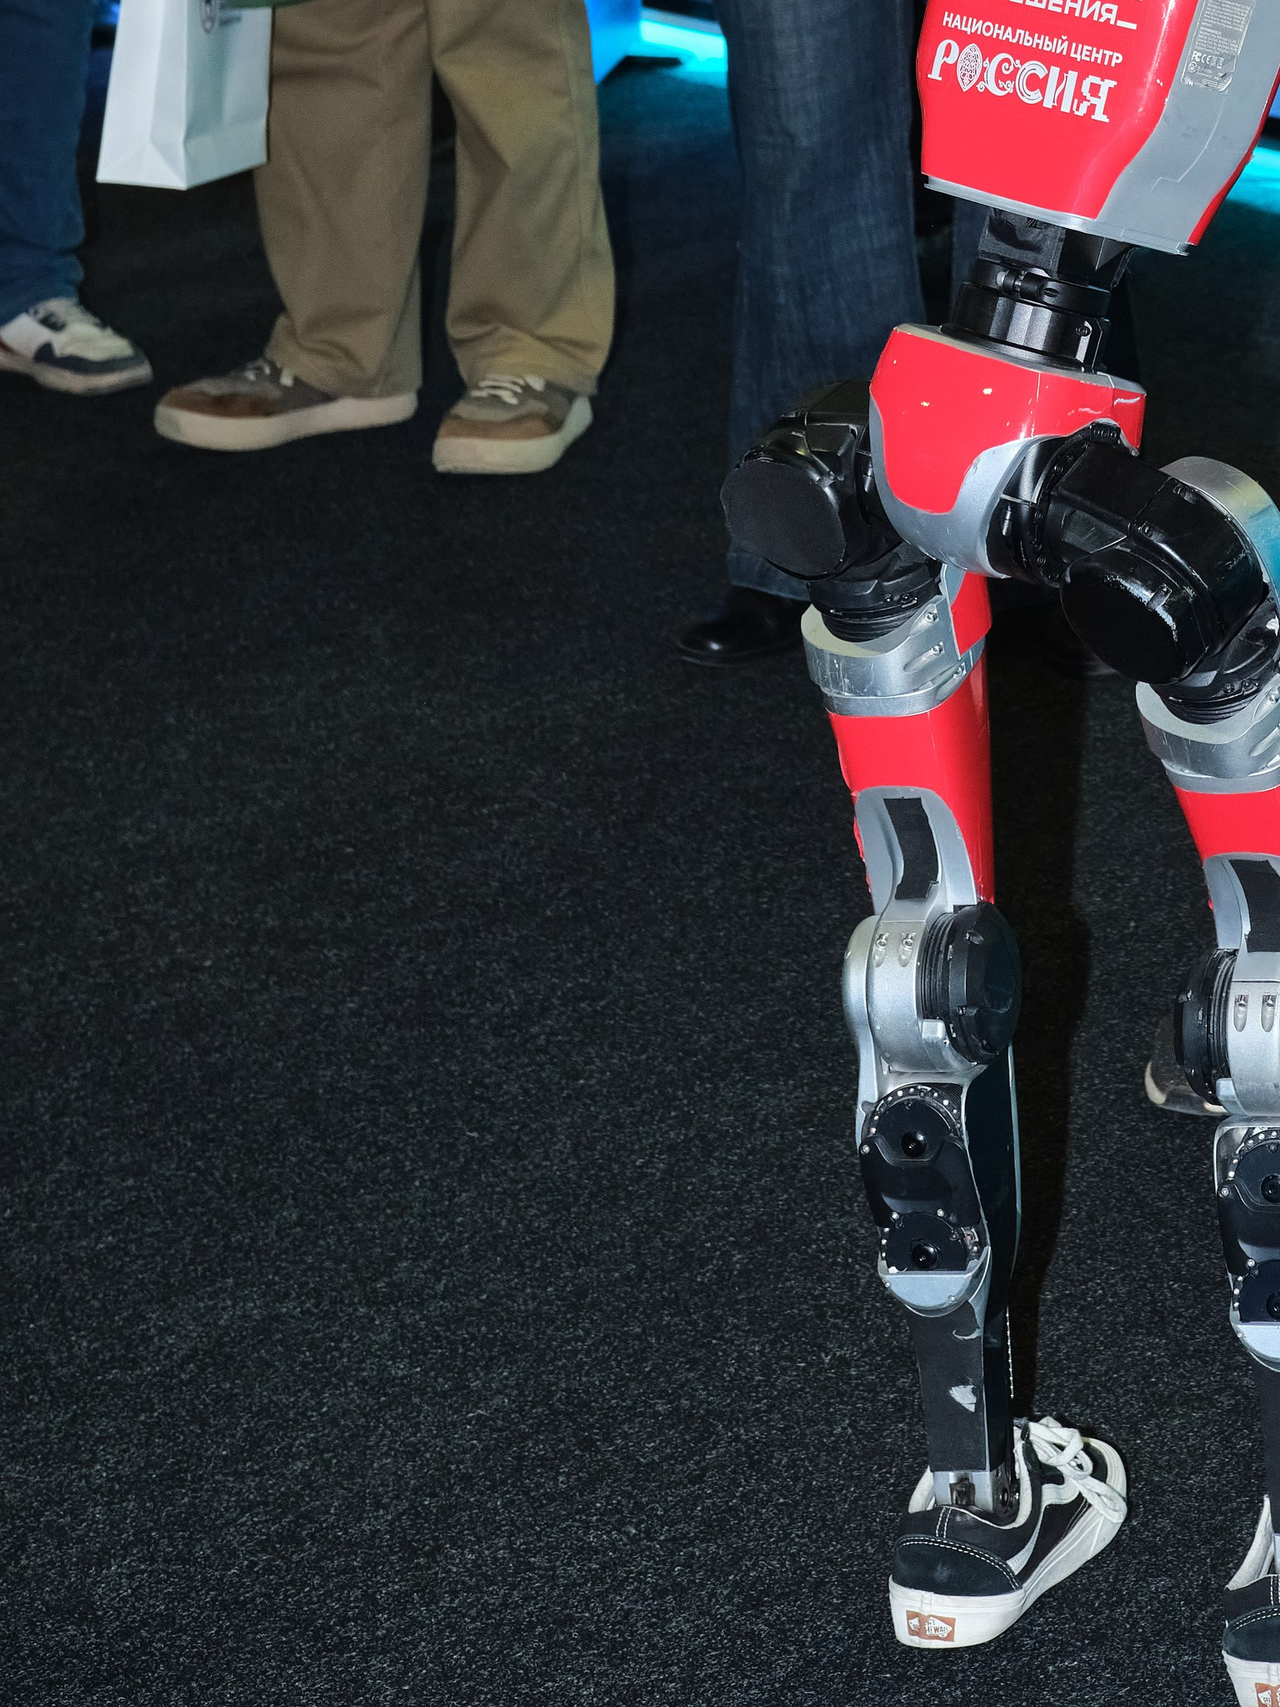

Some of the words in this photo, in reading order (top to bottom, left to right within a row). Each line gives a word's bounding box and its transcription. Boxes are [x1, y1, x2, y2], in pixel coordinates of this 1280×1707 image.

[942, 11, 1068, 56] НАЦИОНАЛЬНЫЙ
[1069, 42, 1124, 68] ЦЕНТР
[927, 38, 1118, 123] РОССИЯ
